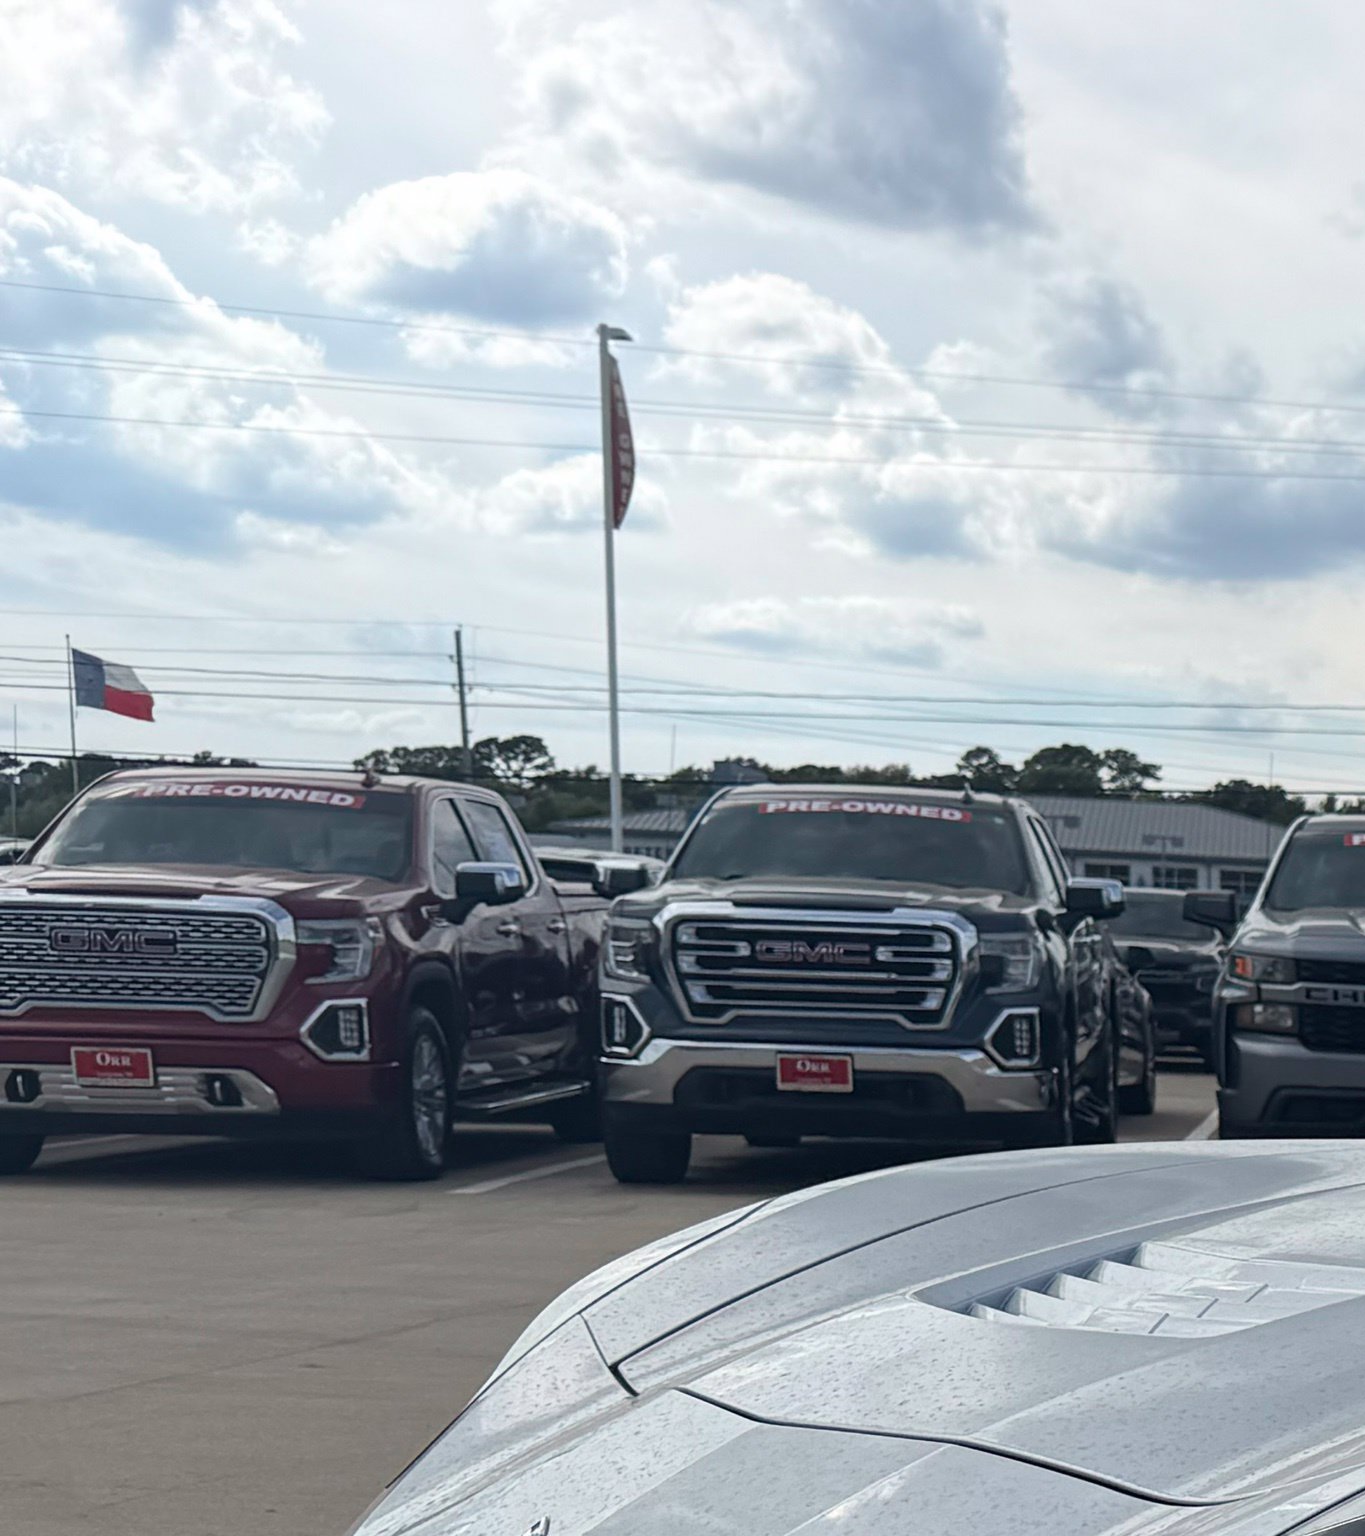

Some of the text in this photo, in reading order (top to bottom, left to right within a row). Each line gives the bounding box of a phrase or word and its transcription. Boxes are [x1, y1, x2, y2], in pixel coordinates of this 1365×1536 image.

[143, 784, 355, 807] PRE-OWNED
[766, 800, 964, 821] PRE-OWNED
[51, 928, 176, 953] GMC
[755, 940, 871, 964] GMC
